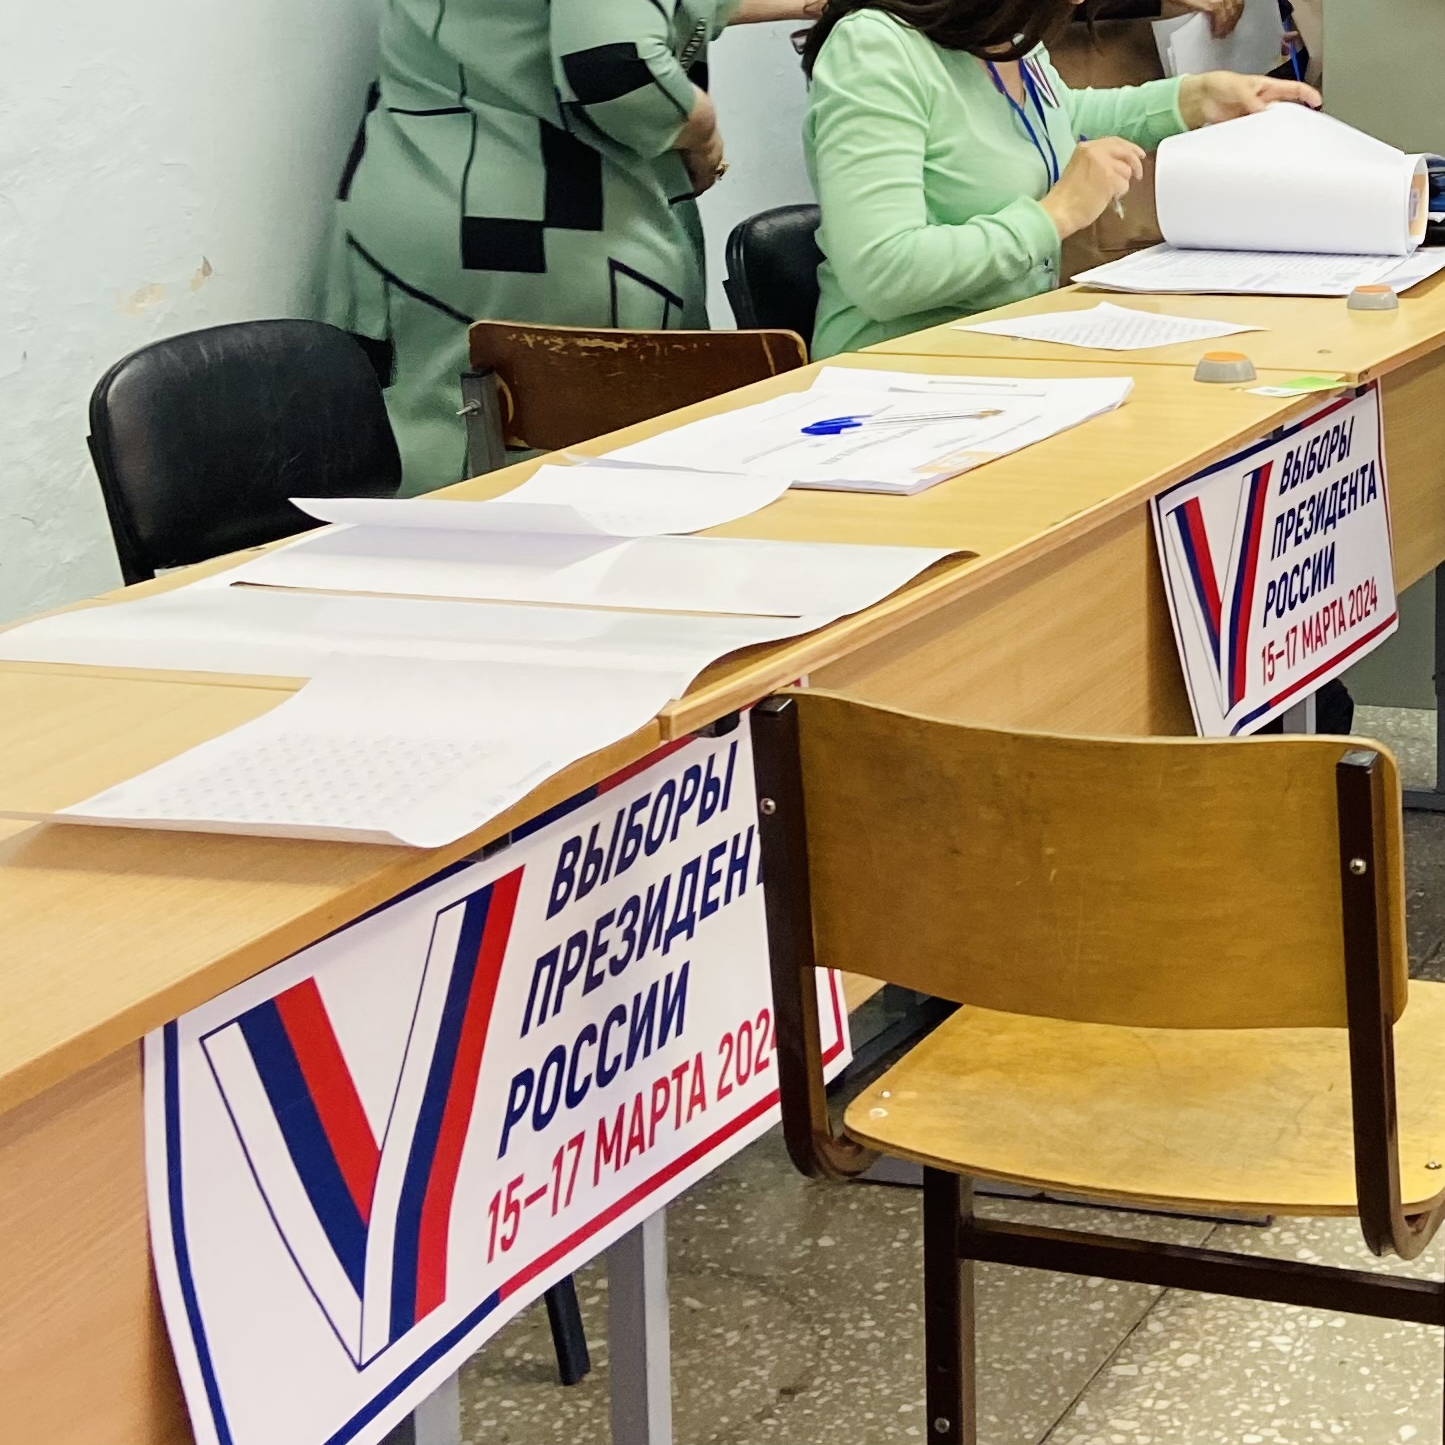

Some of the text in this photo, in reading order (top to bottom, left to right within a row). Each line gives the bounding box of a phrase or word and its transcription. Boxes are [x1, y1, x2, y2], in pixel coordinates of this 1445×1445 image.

[1271, 459, 1378, 562] ПРЕЗИДЕНТА
[1278, 416, 1355, 496] ВЫБОРЫ
[1262, 541, 1336, 628] РОССИИ
[1301, 599, 1347, 658] МАРТА
[1349, 576, 1378, 628] 2024
[546, 741, 738, 921] ВЫБОРЫ
[520, 823, 764, 1039] ПРЕЗИДЕН
[497, 961, 690, 1160] РОССИИ
[593, 1051, 707, 1187] МАРТА
[716, 1008, 777, 1102] 202
